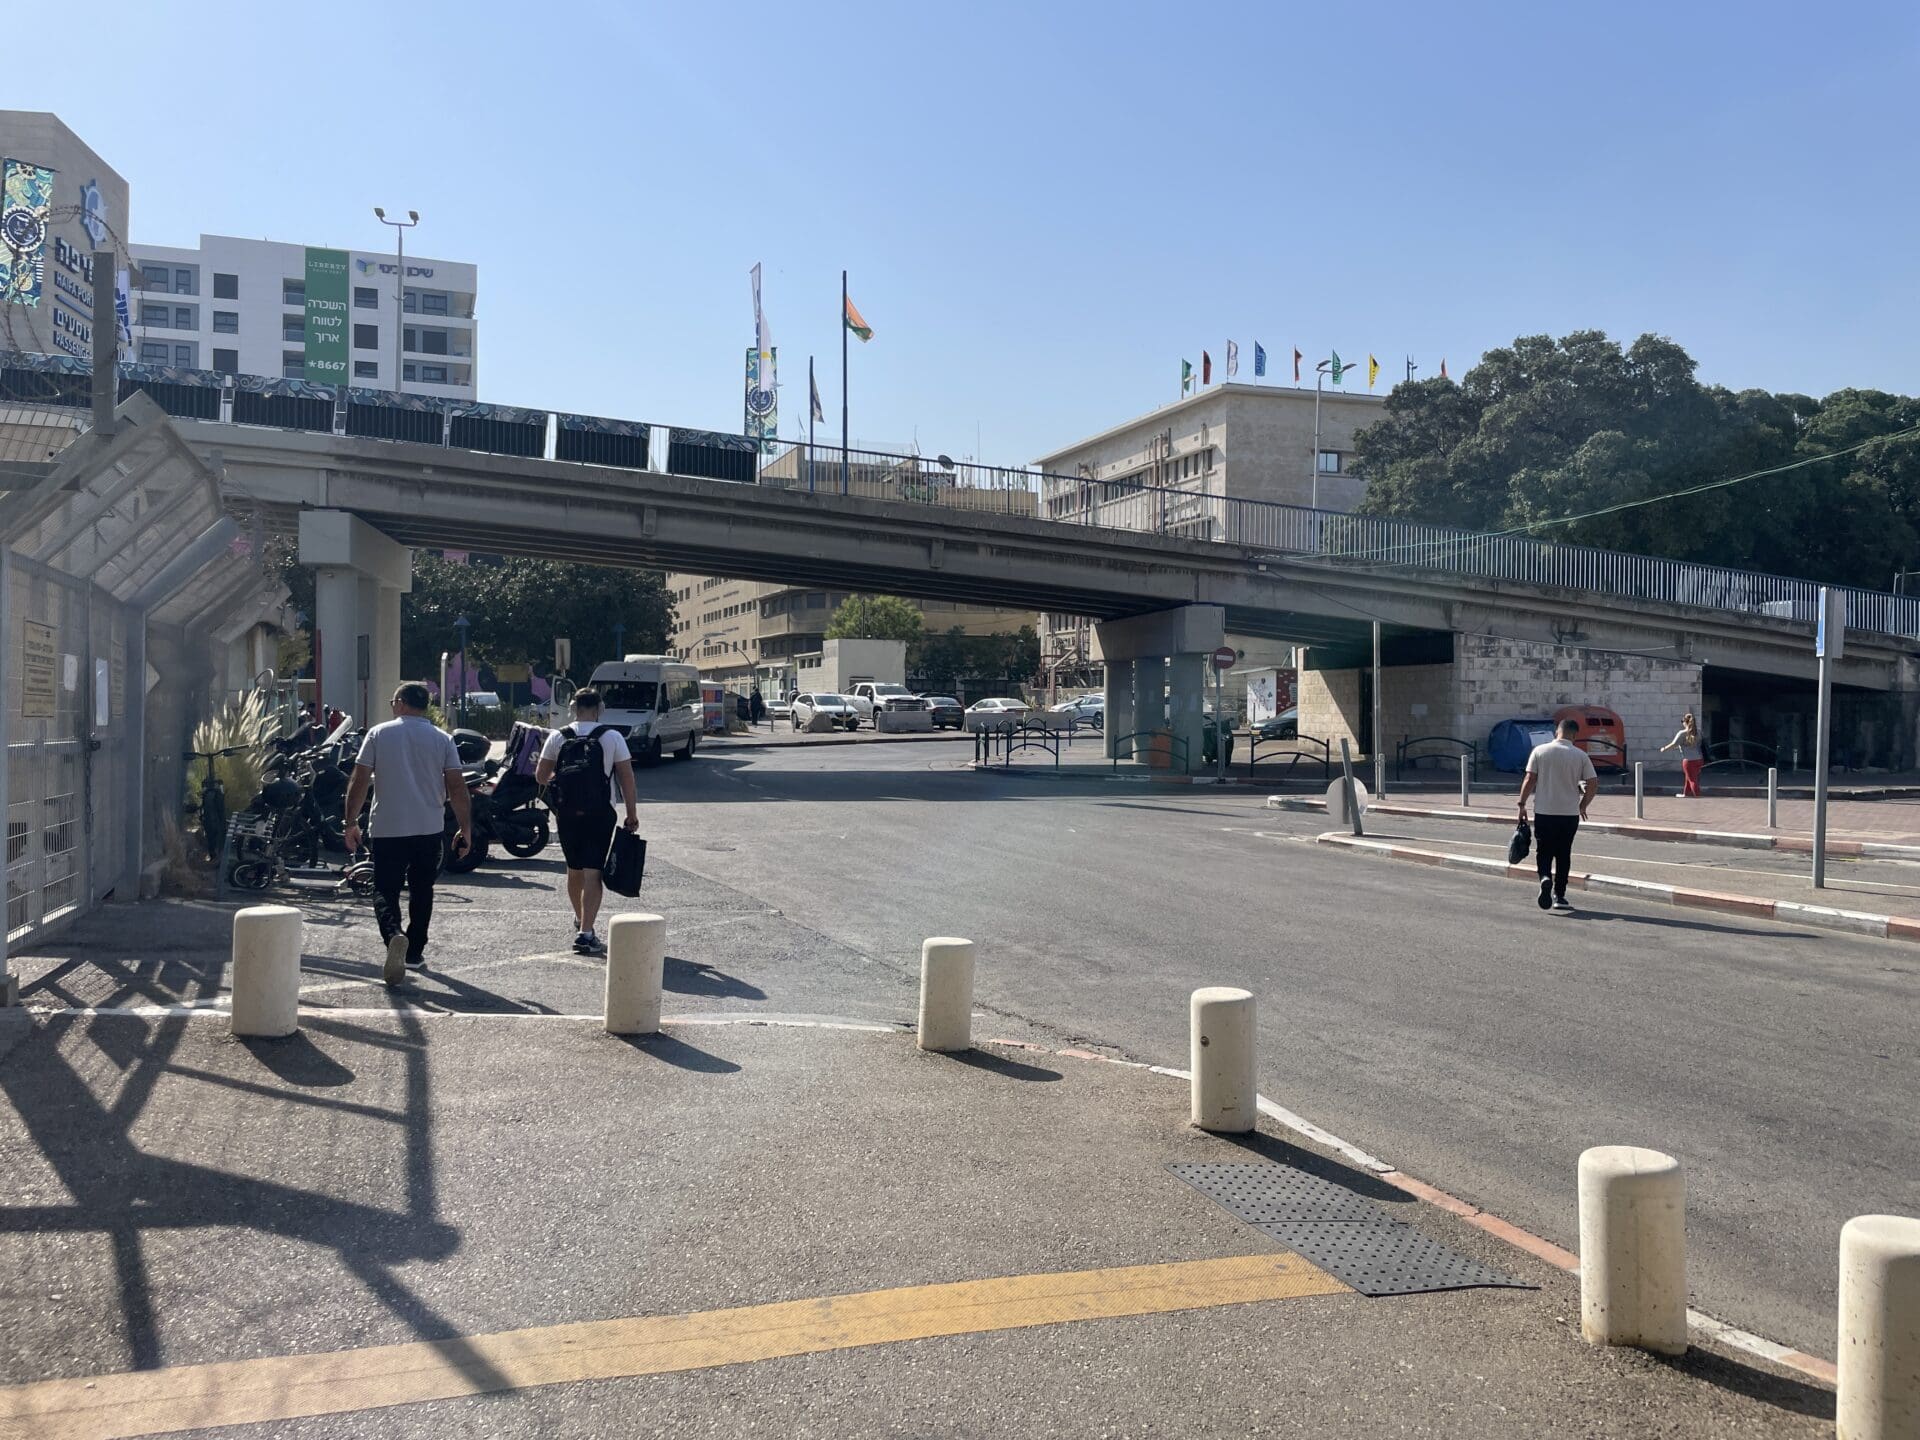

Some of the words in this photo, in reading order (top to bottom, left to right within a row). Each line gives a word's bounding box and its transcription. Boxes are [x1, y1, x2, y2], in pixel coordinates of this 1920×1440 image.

[407, 266, 433, 278] שיכון
[56, 271, 77, 297] HAIFA
[307, 298, 346, 312] השכרה
[312, 315, 342, 327] לטווח
[314, 332, 340, 344] ארוך
